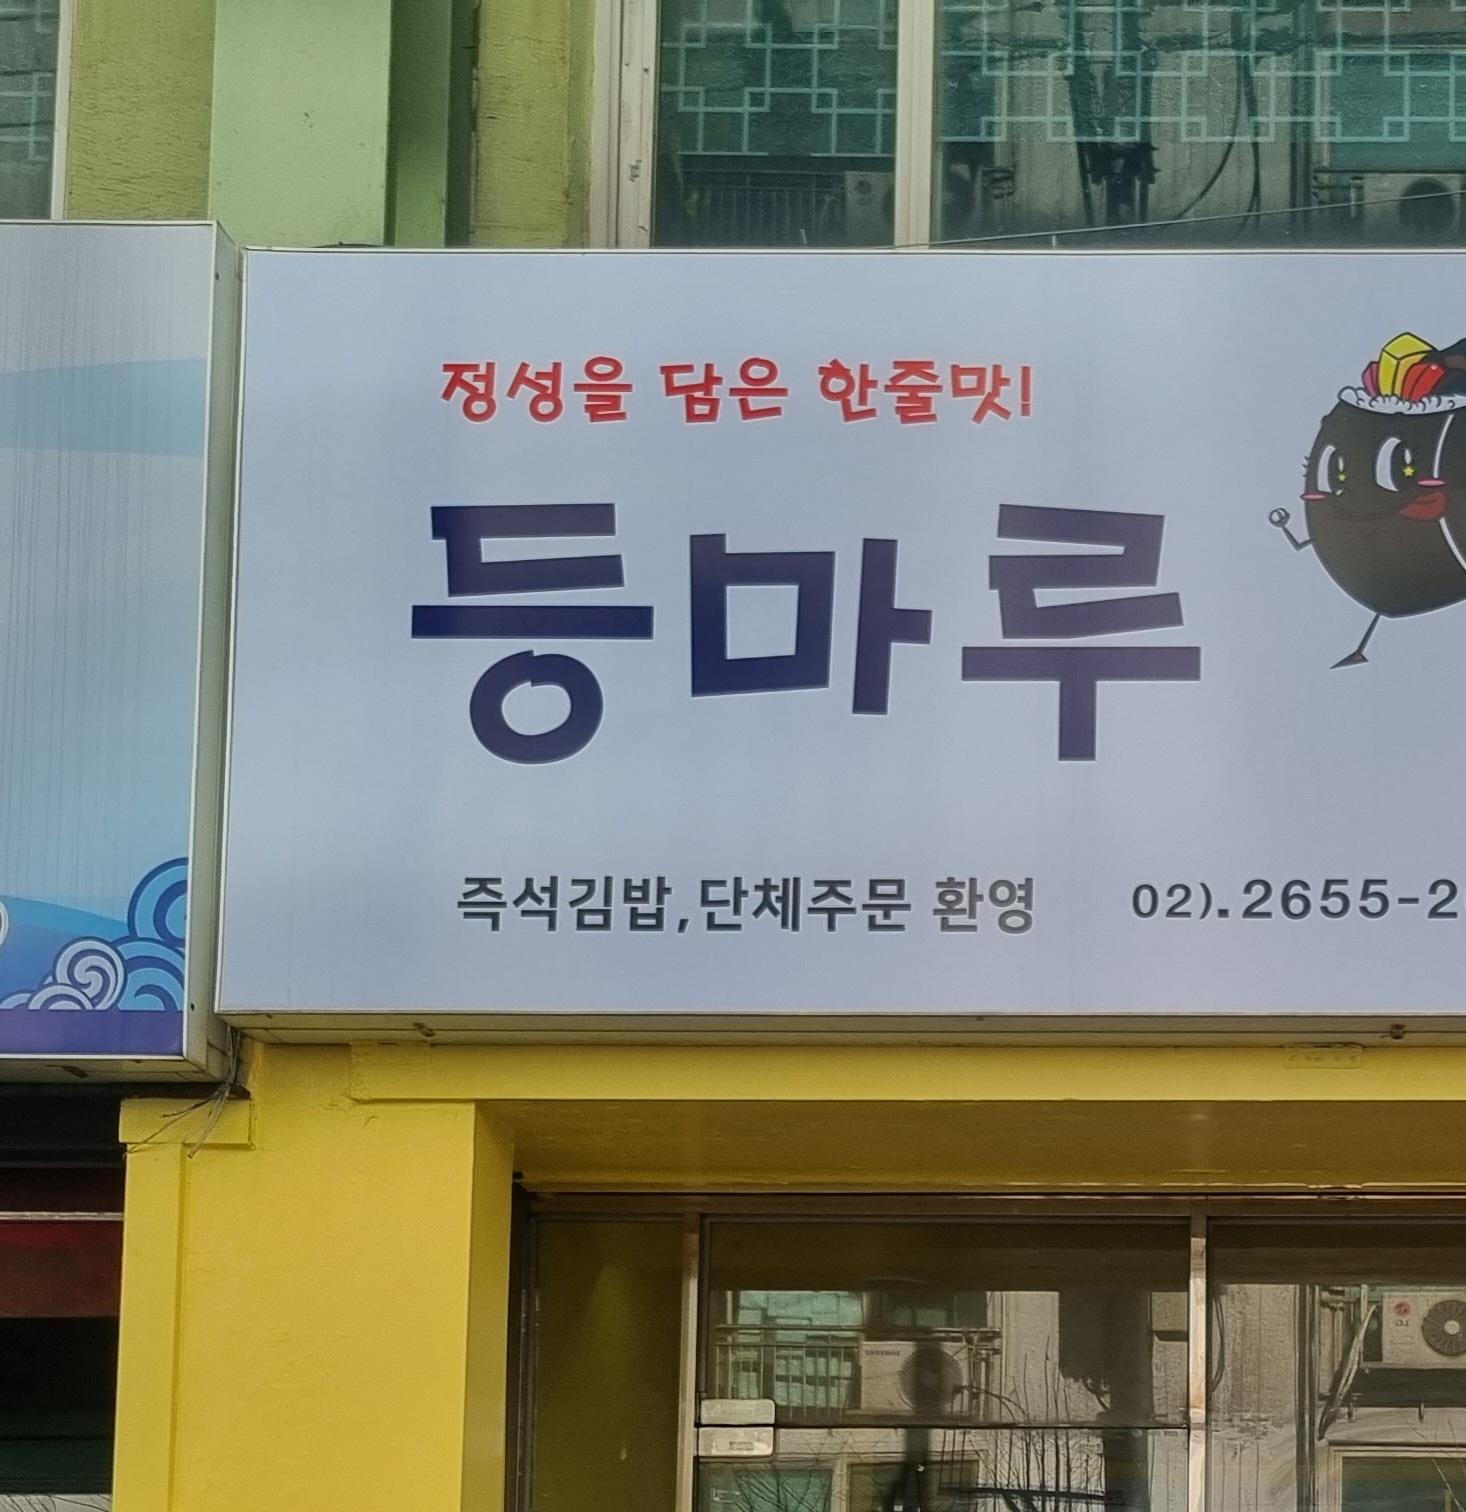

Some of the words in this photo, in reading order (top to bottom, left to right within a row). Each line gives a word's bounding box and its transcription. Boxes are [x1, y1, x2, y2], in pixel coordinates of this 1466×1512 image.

[442, 356, 633, 423] 정성을
[662, 356, 789, 423] 담은
[411, 502, 1200, 765] 등마루
[932, 874, 1036, 934] 환영
